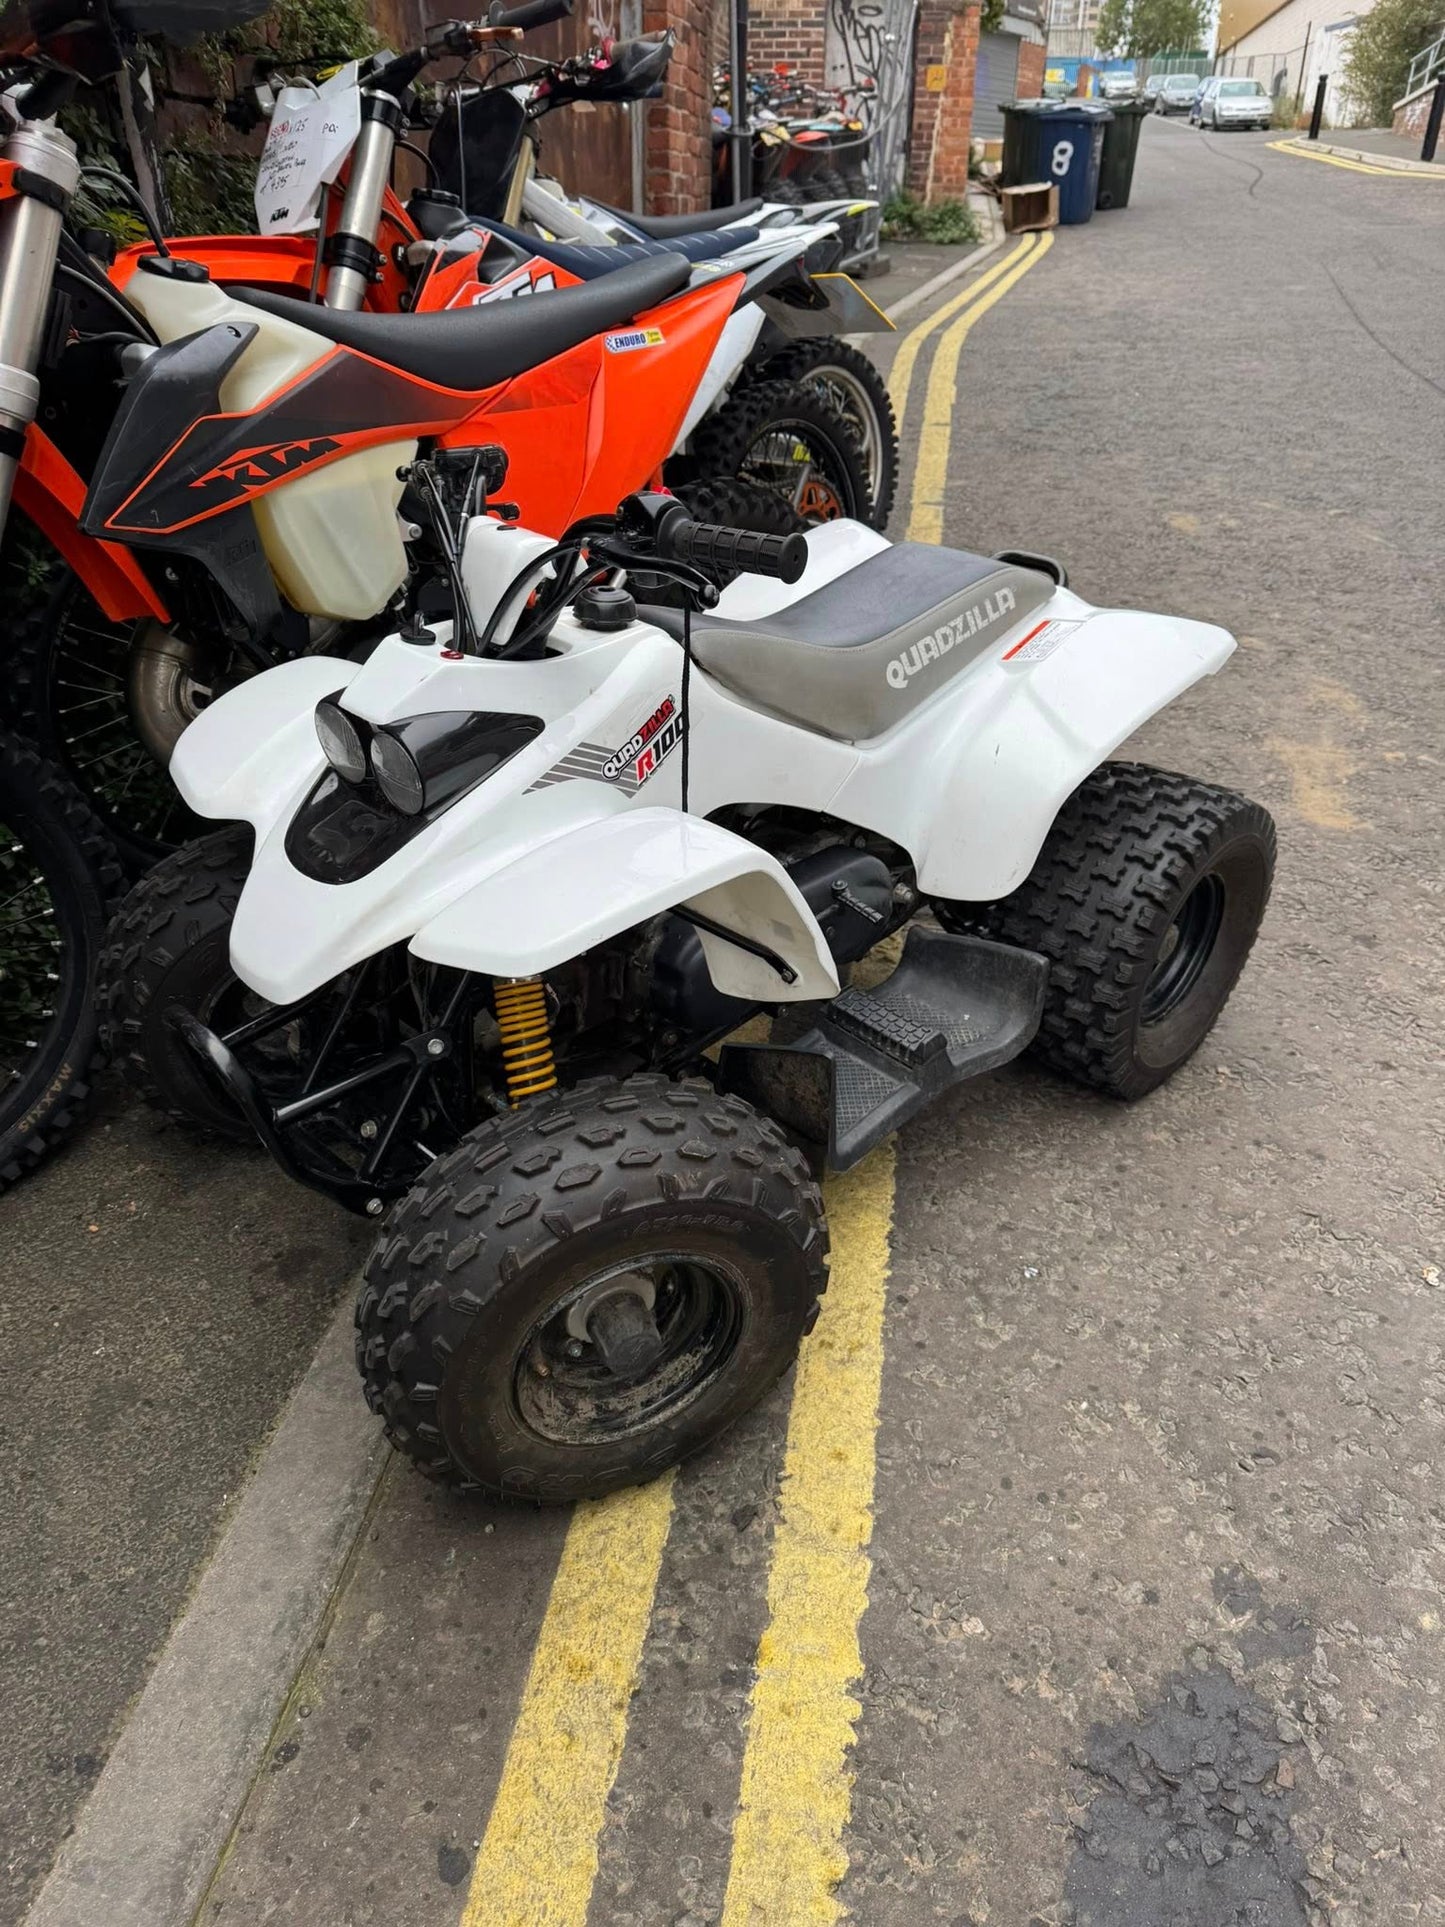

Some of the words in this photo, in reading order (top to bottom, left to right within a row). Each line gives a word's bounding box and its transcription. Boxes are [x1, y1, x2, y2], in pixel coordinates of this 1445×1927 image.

[1051, 140, 1074, 176] 8
[269, 206, 289, 223] KTM
[614, 333, 647, 348] ENDURO
[188, 437, 344, 493] KTM
[886, 587, 1016, 689] QUADZILLA
[603, 698, 675, 779] QUADZILLA
